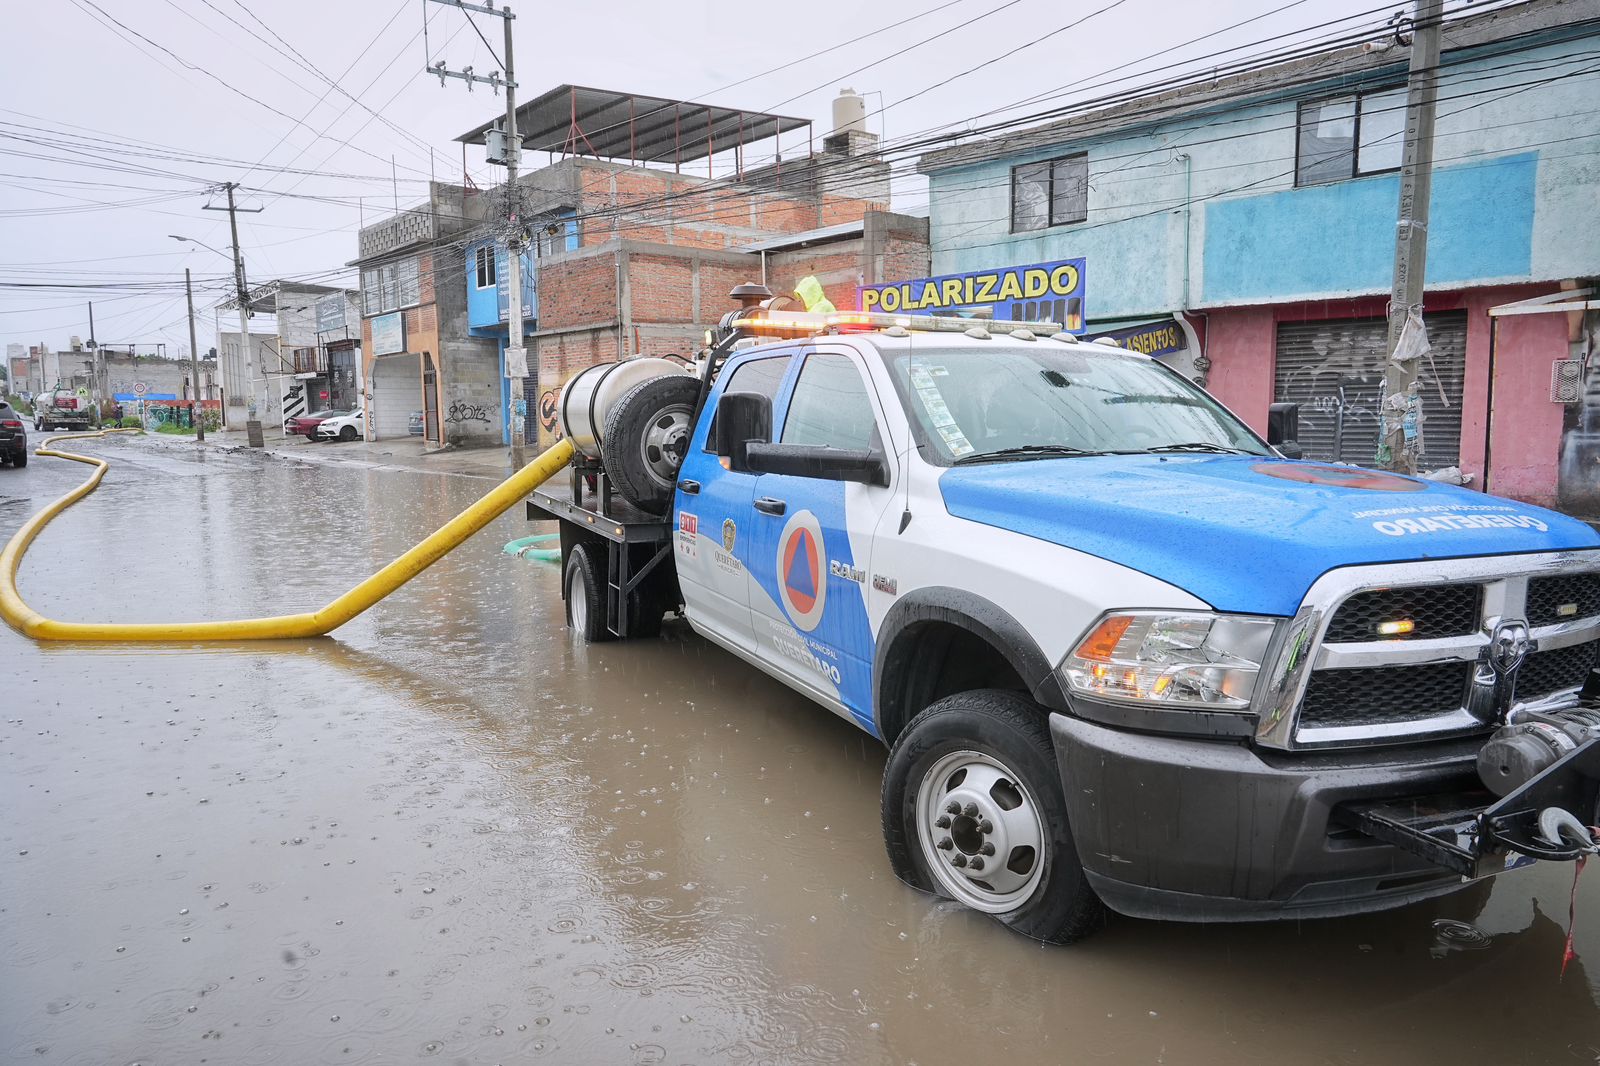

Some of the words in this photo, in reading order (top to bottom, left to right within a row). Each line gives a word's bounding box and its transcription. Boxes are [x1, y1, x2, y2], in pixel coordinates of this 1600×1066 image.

[861, 264, 1079, 314] POLARIZADO
[1126, 326, 1178, 354] ASIENTOS
[681, 514, 696, 534] 911
[830, 560, 865, 583] RAM
[773, 635, 841, 685] QUERÉTARO
